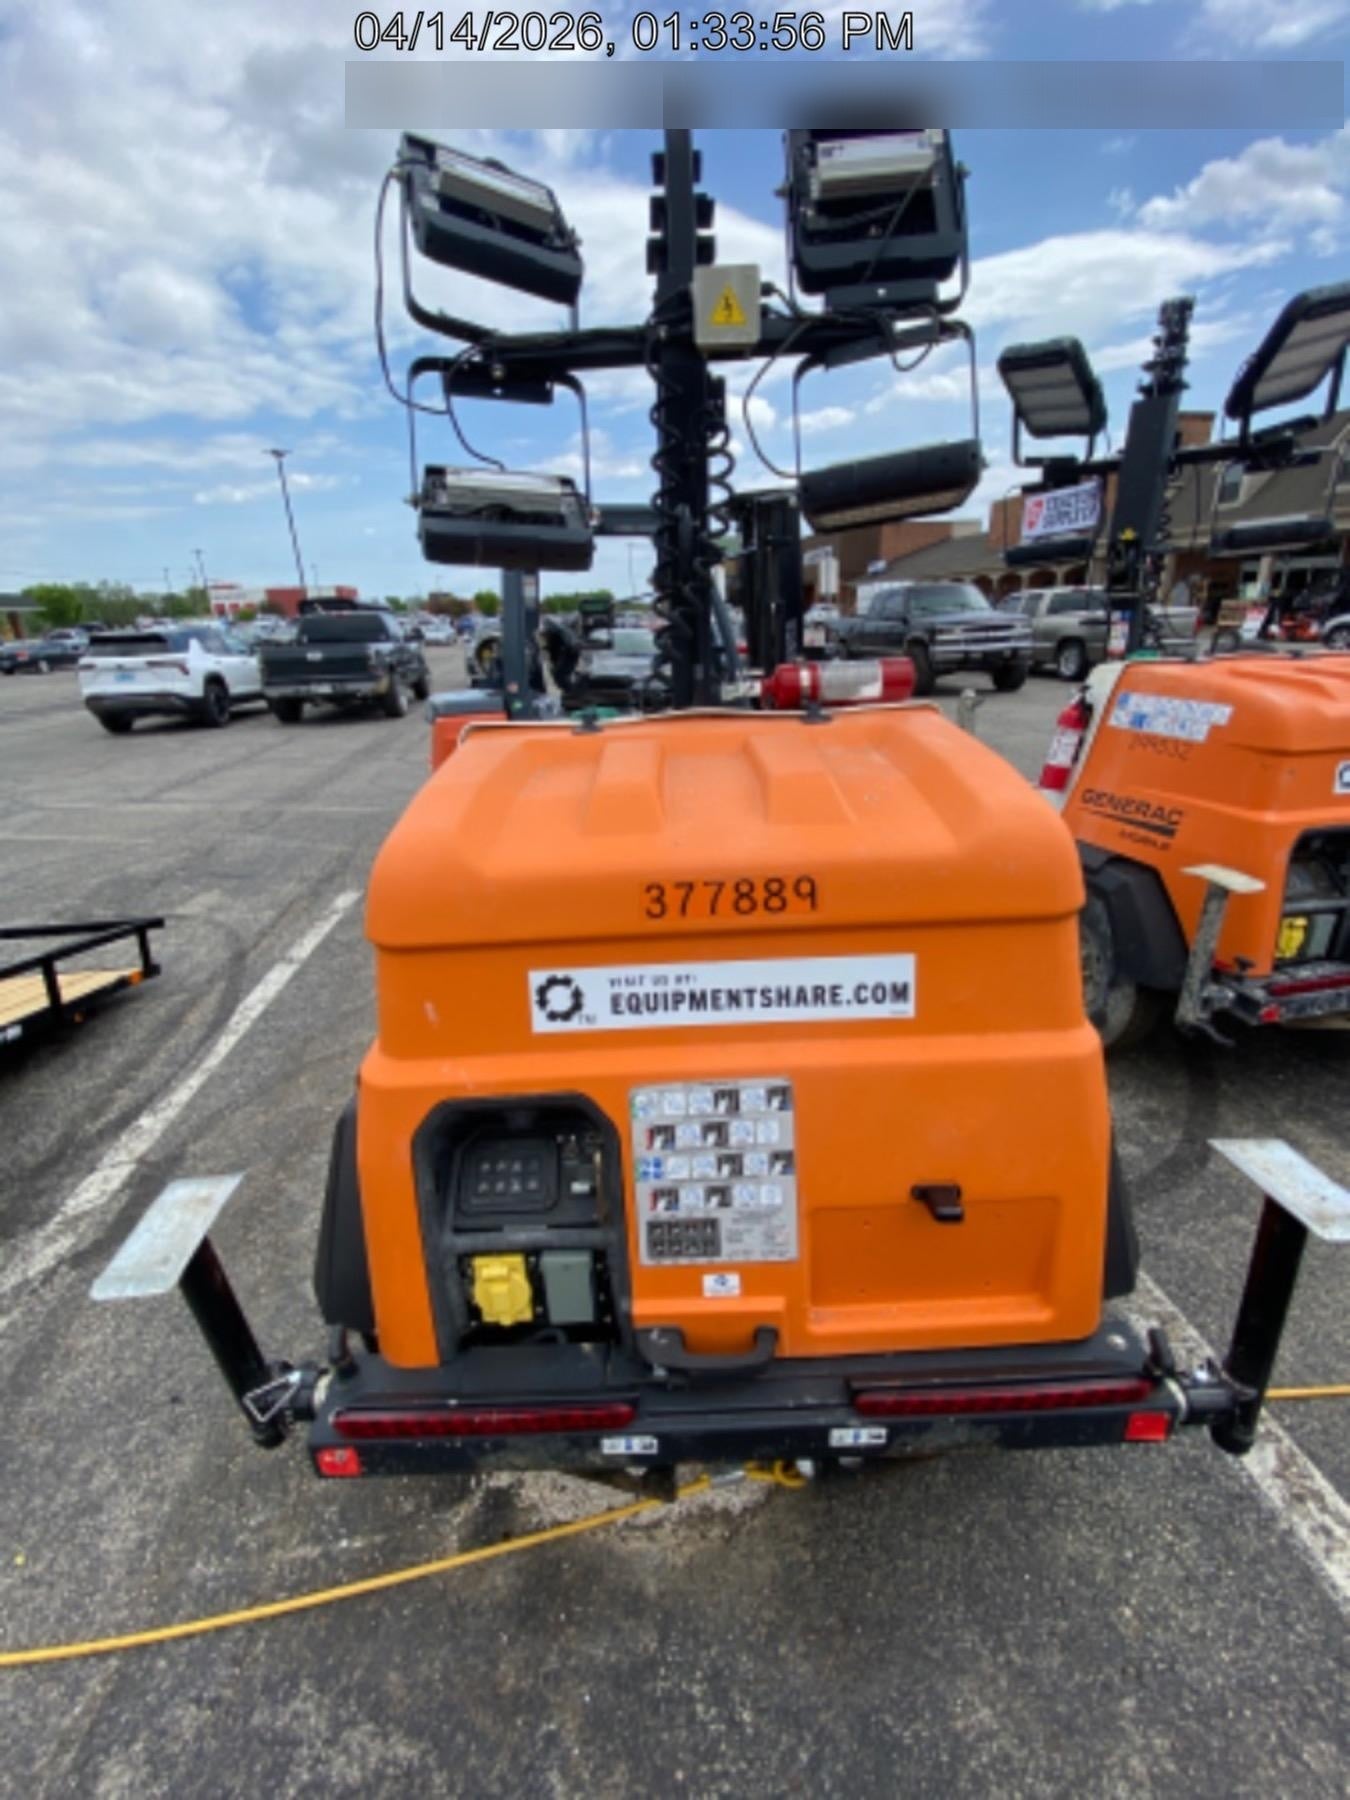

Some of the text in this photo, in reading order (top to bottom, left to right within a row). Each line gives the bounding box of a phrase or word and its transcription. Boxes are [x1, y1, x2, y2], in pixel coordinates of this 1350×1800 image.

[1082, 788, 1184, 826] GENERAC
[644, 875, 819, 920] 377889
[609, 981, 910, 1016] EQUIPMENTSHARE.COM
